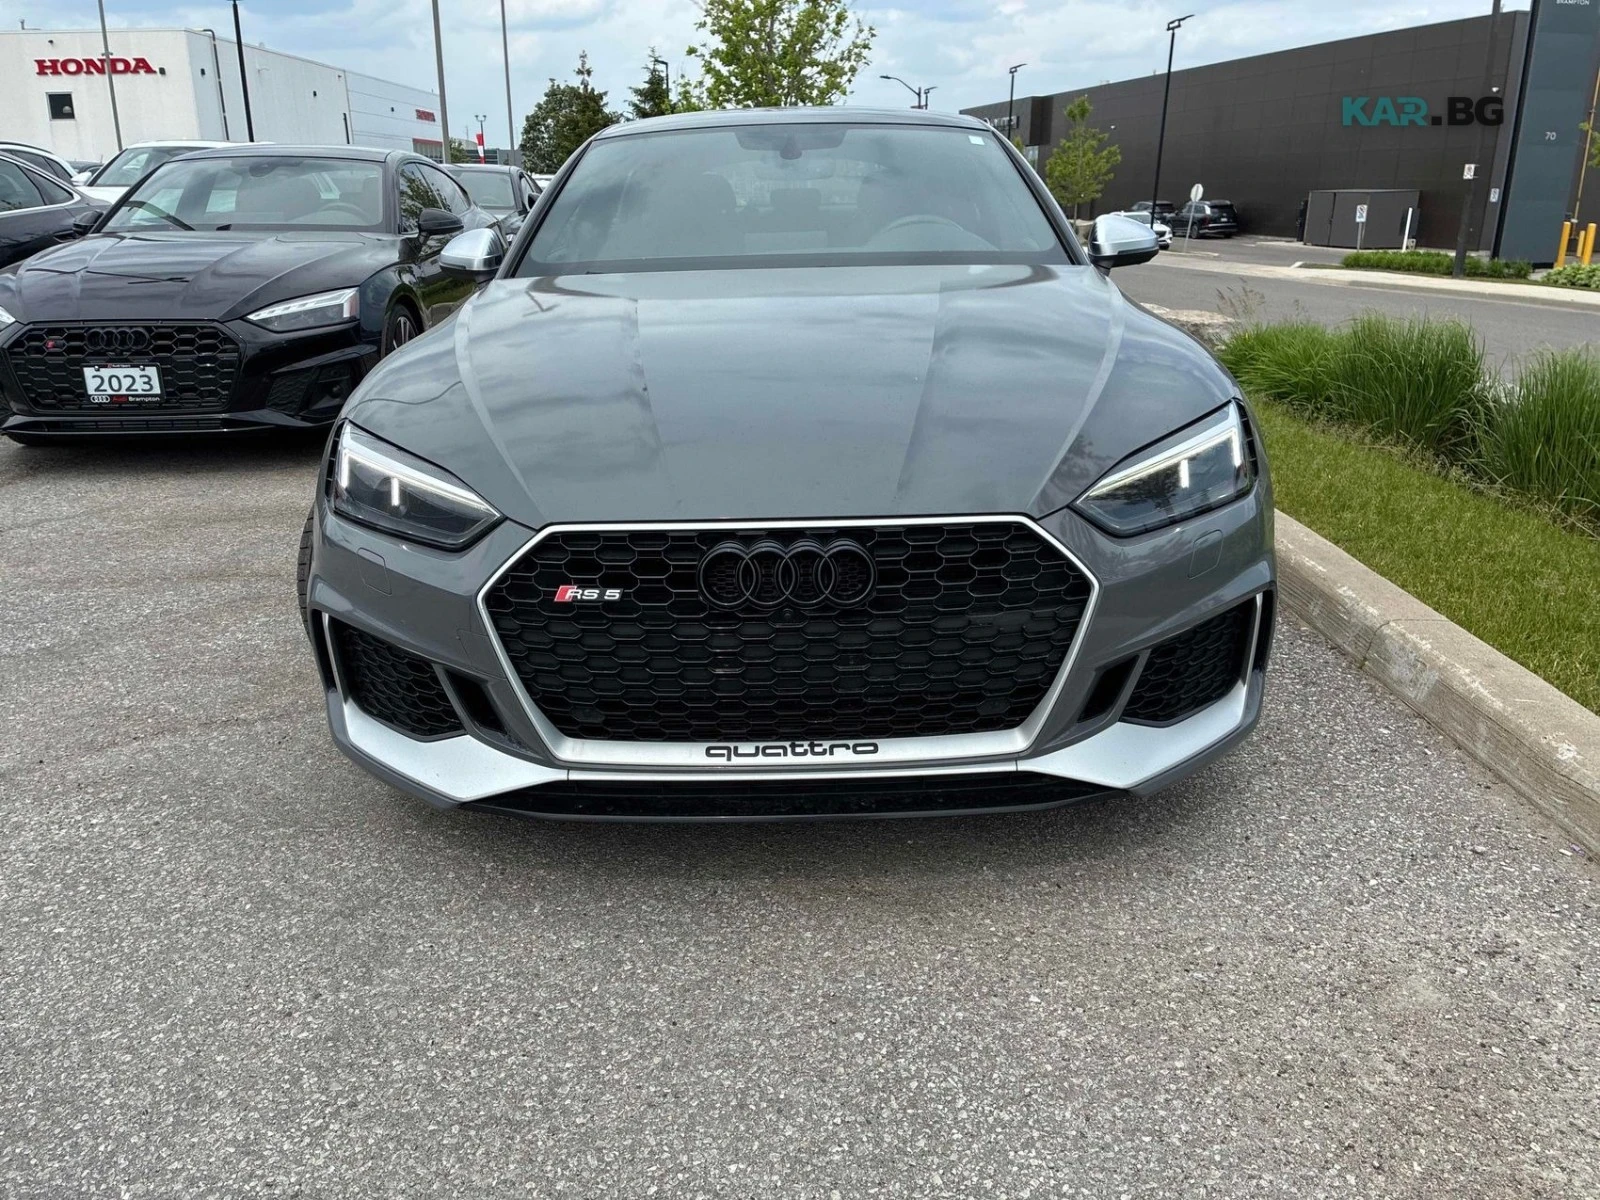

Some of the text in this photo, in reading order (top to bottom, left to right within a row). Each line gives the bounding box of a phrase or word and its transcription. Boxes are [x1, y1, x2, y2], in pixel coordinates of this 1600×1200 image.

[34, 57, 157, 76] HONDA
[1545, 131, 1557, 141] 70
[91, 374, 154, 393] 2023
[705, 741, 879, 762] quattro
